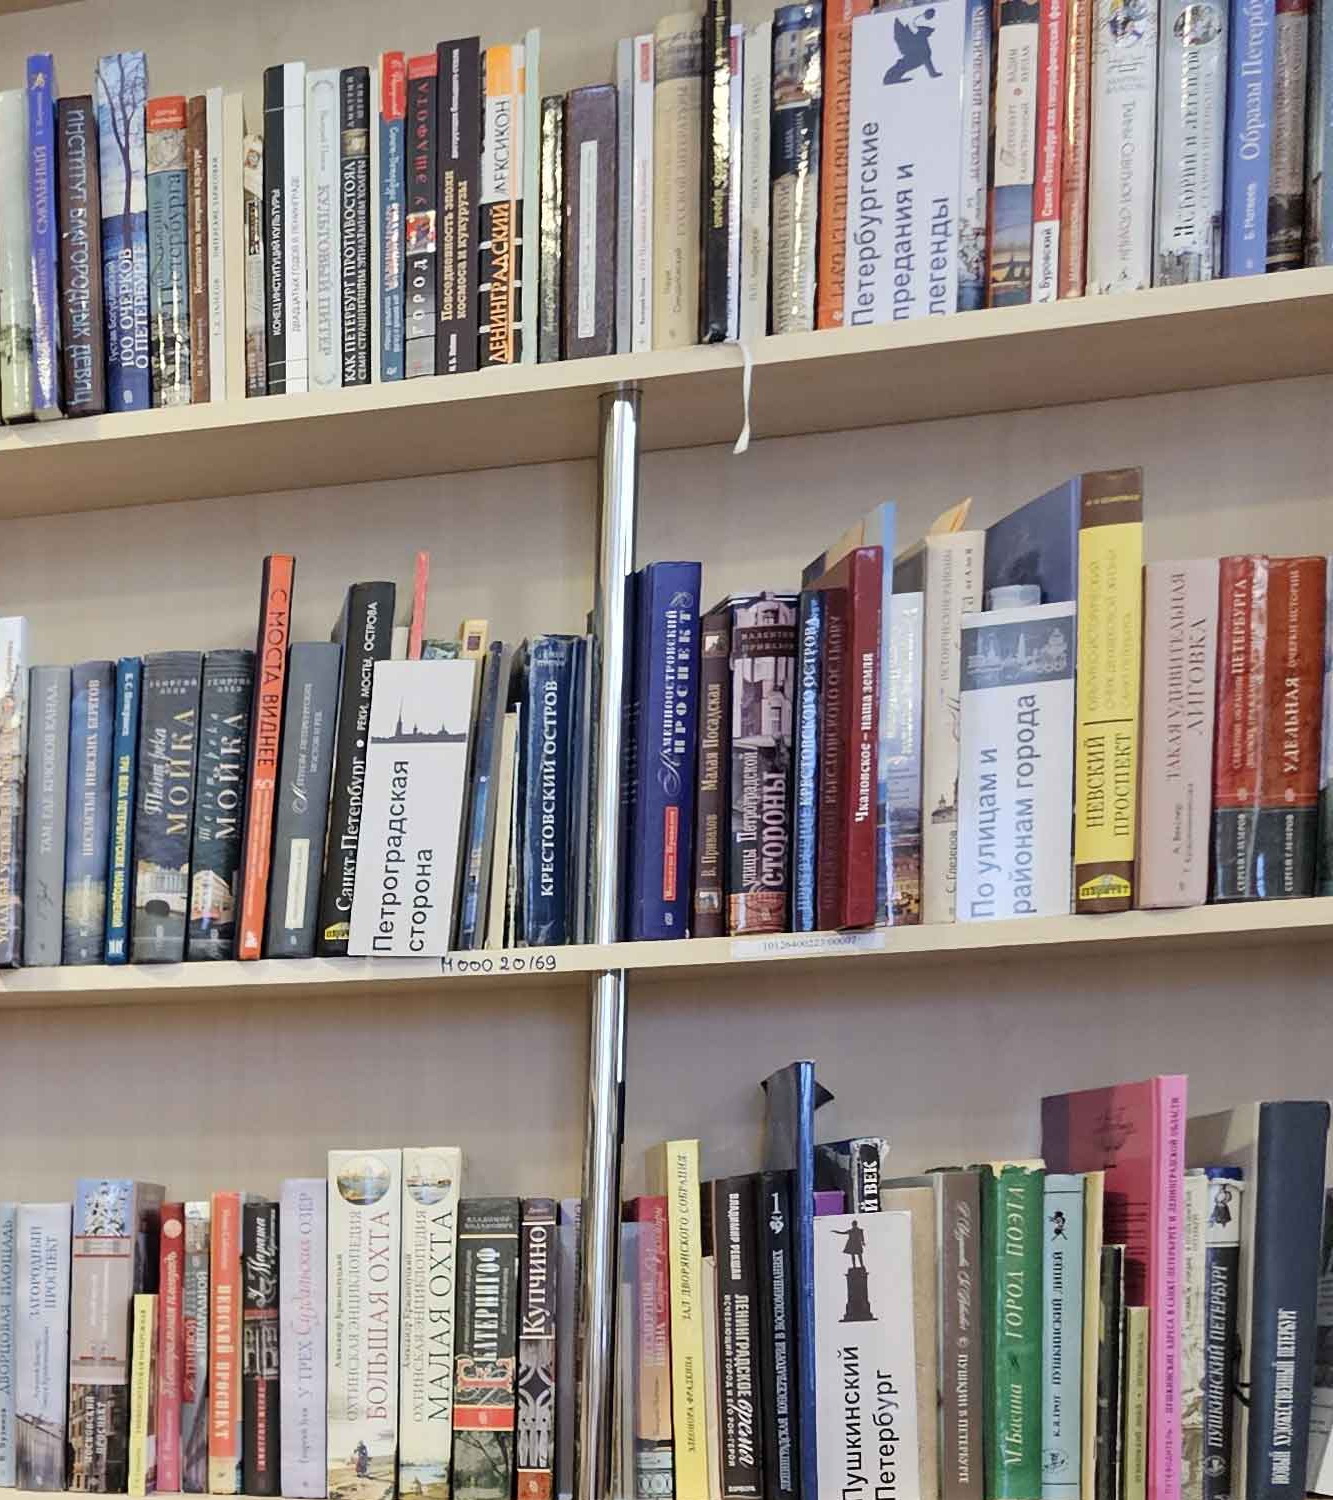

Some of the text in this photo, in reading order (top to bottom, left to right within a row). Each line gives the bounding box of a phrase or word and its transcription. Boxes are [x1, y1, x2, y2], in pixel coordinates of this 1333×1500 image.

[492, 99, 510, 194] ЛЕКСИКОН
[1239, 82, 1265, 161] Образы
[68, 109, 92, 404] ИНСТИТУТ БЛАГОРОДНЫХ ДЕВИЦ
[343, 159, 357, 382] КАК ПЕТЕРБУРГ ПРОТИВОСТОЯЛ
[440, 170, 456, 321] Повседневность эпохи
[489, 202, 511, 361] ЛЕНИНГРАДСКИЙ
[849, 121, 883, 327] Петербургские
[891, 162, 917, 321] предания и
[927, 197, 954, 315] легенды
[1036, 228, 1054, 289] Буровский
[119, 247, 135, 368] 100 ОЧЕРКОВ
[257, 588, 288, 768] С МОСТА ВИДНЕЕ
[1164, 572, 1185, 783] ТАКАЯ УДИВИТЕЛЬНАЯ
[1186, 617, 1207, 737] ЛИГОВКА
[1230, 579, 1248, 675] ПЕТЕРБУРГА
[166, 706, 196, 837] МОЙКА
[214, 711, 244, 840] МОЙКА
[540, 680, 559, 897] КРЕСТОВСКИЙ ОСТРОВ
[701, 683, 721, 864] Привалов Малая Посадская
[854, 652, 875, 822] Чкаловское наша земля
[1008, 693, 1041, 914] районам города
[1083, 735, 1105, 829] НЕВСКИЙ
[1111, 731, 1133, 837] ПРОСПЕКТ
[373, 760, 410, 953] Петроградская
[409, 848, 434, 953] сторона
[970, 747, 1002, 919] По улицам и
[860, 1160, 879, 1195] ВЕК
[0, 1219, 14, 1297] ПЛОЩАДЬ
[367, 1210, 391, 1420] БОЛЬШАЯ ОХТА
[428, 1210, 453, 1421] МАЛАЯ ОХТА
[521, 1225, 551, 1335] Купчино
[1006, 1183, 1026, 1340] ГОРОД ПОЭТА
[1050, 1250, 1065, 1386] ПУШКИНСКИЙ ЛИЦЕЙ
[734, 1293, 754, 1467] ЛЕНИНГРАДСКОЕ время
[1207, 1261, 1229, 1448] ПУШКИНСКИЙ ПЕТЕРБУРГ
[1269, 1309, 1297, 1485] НОВЫЙ ХУДОЖЕСТВЕННЫЙ ПЕТЕРБУРГ
